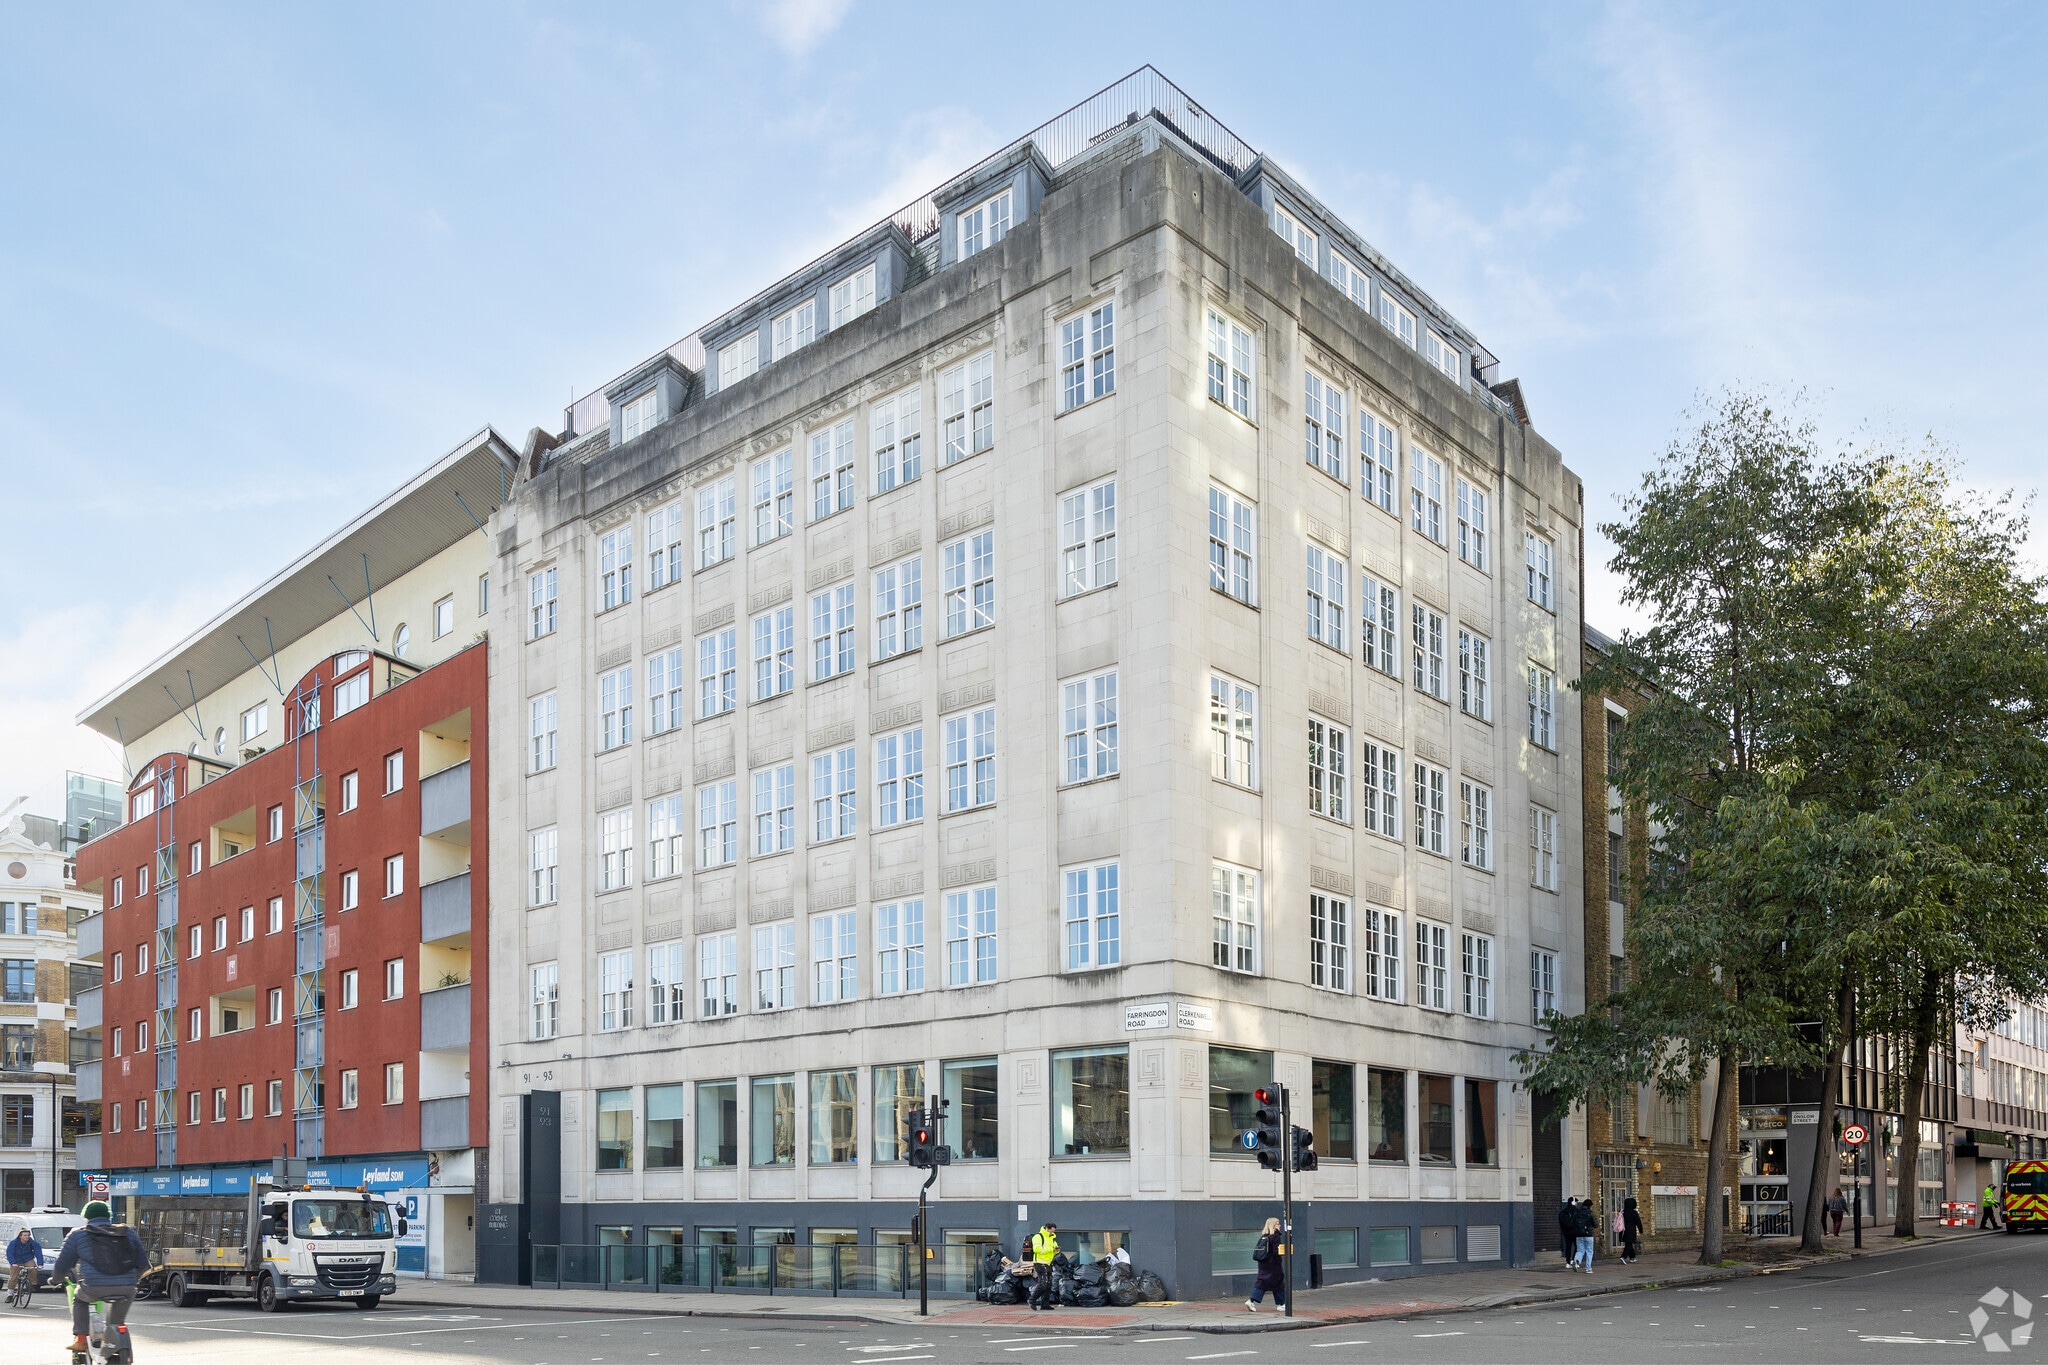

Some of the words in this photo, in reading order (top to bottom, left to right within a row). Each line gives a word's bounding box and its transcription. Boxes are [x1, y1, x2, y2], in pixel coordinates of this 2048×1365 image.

[1127, 1010, 1167, 1019] FARRINGDON
[1179, 1018, 1194, 1026] ROAD
[523, 1073, 531, 1083] 91
[543, 1070, 553, 1081] 93
[540, 1106, 550, 1116] 91
[540, 1117, 552, 1126] 93
[1847, 1130, 1863, 1139] 20
[307, 1170, 327, 1178] PLUMBING
[363, 1167, 391, 1184] Leyland
[391, 1171, 404, 1181] SDM
[182, 1175, 200, 1189] Leyland
[200, 1178, 209, 1187] SDM
[1760, 1186, 1779, 1200] 67
[408, 1200, 415, 1215] P
